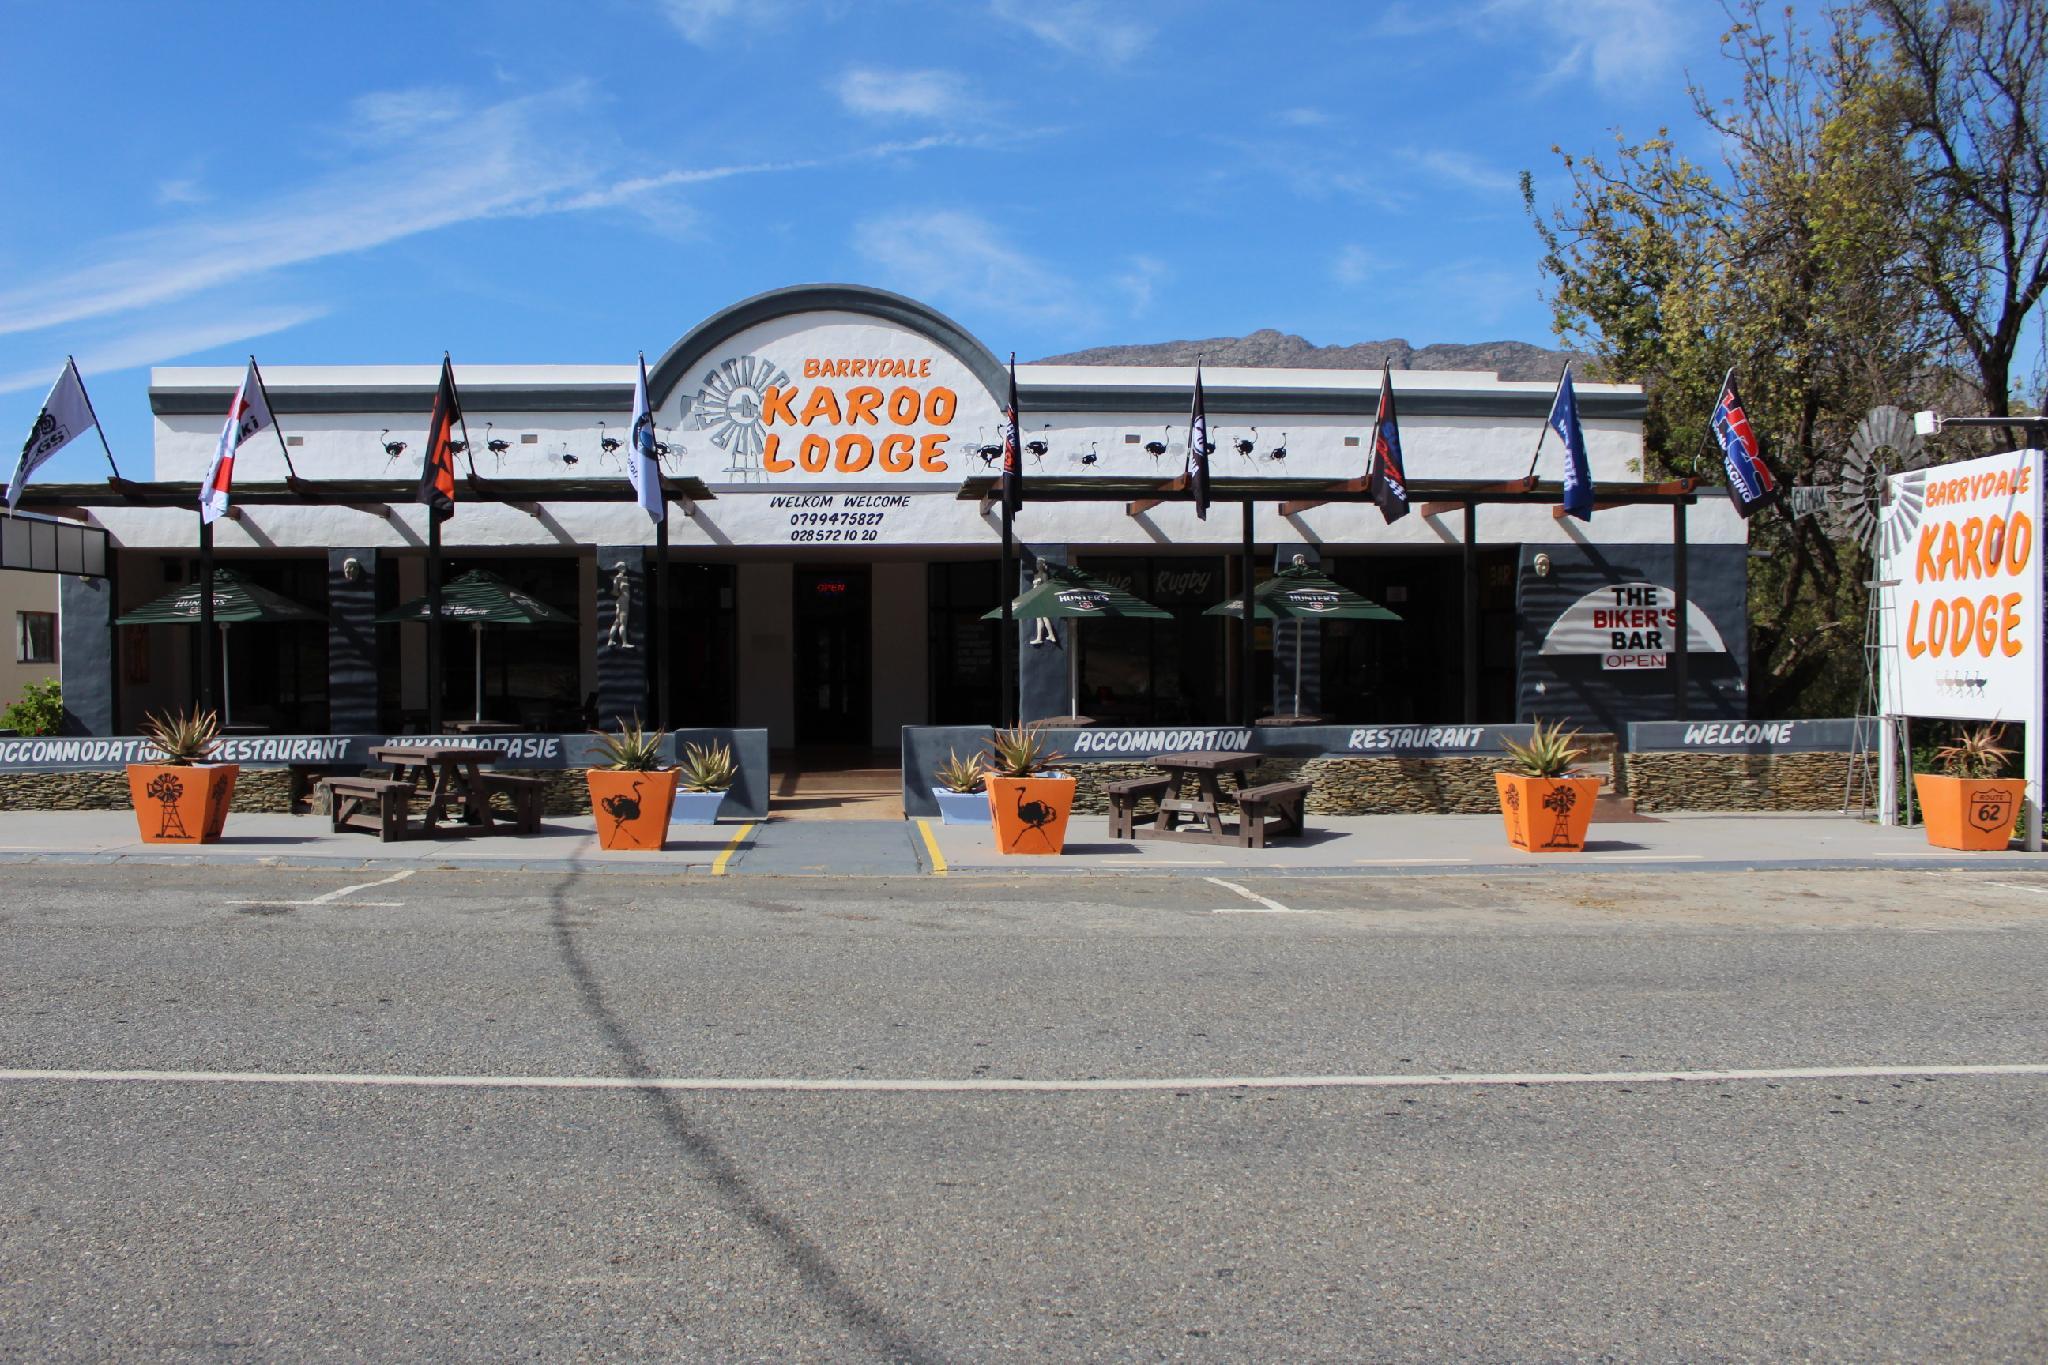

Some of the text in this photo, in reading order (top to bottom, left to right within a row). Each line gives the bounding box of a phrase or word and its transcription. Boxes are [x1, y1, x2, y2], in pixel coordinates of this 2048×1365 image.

[803, 358, 932, 378] BARRYDALE
[762, 385, 958, 427] KAROO
[763, 433, 951, 473] LODGE
[1925, 466, 2032, 508] BARRYDALE
[769, 495, 912, 508] WELKOM WELCOME
[790, 512, 885, 526] 0799475827
[1915, 510, 2032, 585] KAROO
[1155, 569, 1213, 595] Rugby
[1611, 587, 1657, 606] THE
[1593, 610, 1677, 629] BIKER'S
[1906, 592, 2023, 660] LODGE
[1611, 631, 1664, 650] BAR
[1606, 654, 1665, 668] OPEN
[1074, 730, 1252, 752] ACCOMMODATION
[1348, 728, 1485, 749] RESTAURANT
[1683, 723, 1796, 745] WELCOME
[207, 738, 351, 761] RESTAURANT
[1978, 804, 2001, 822] 62
